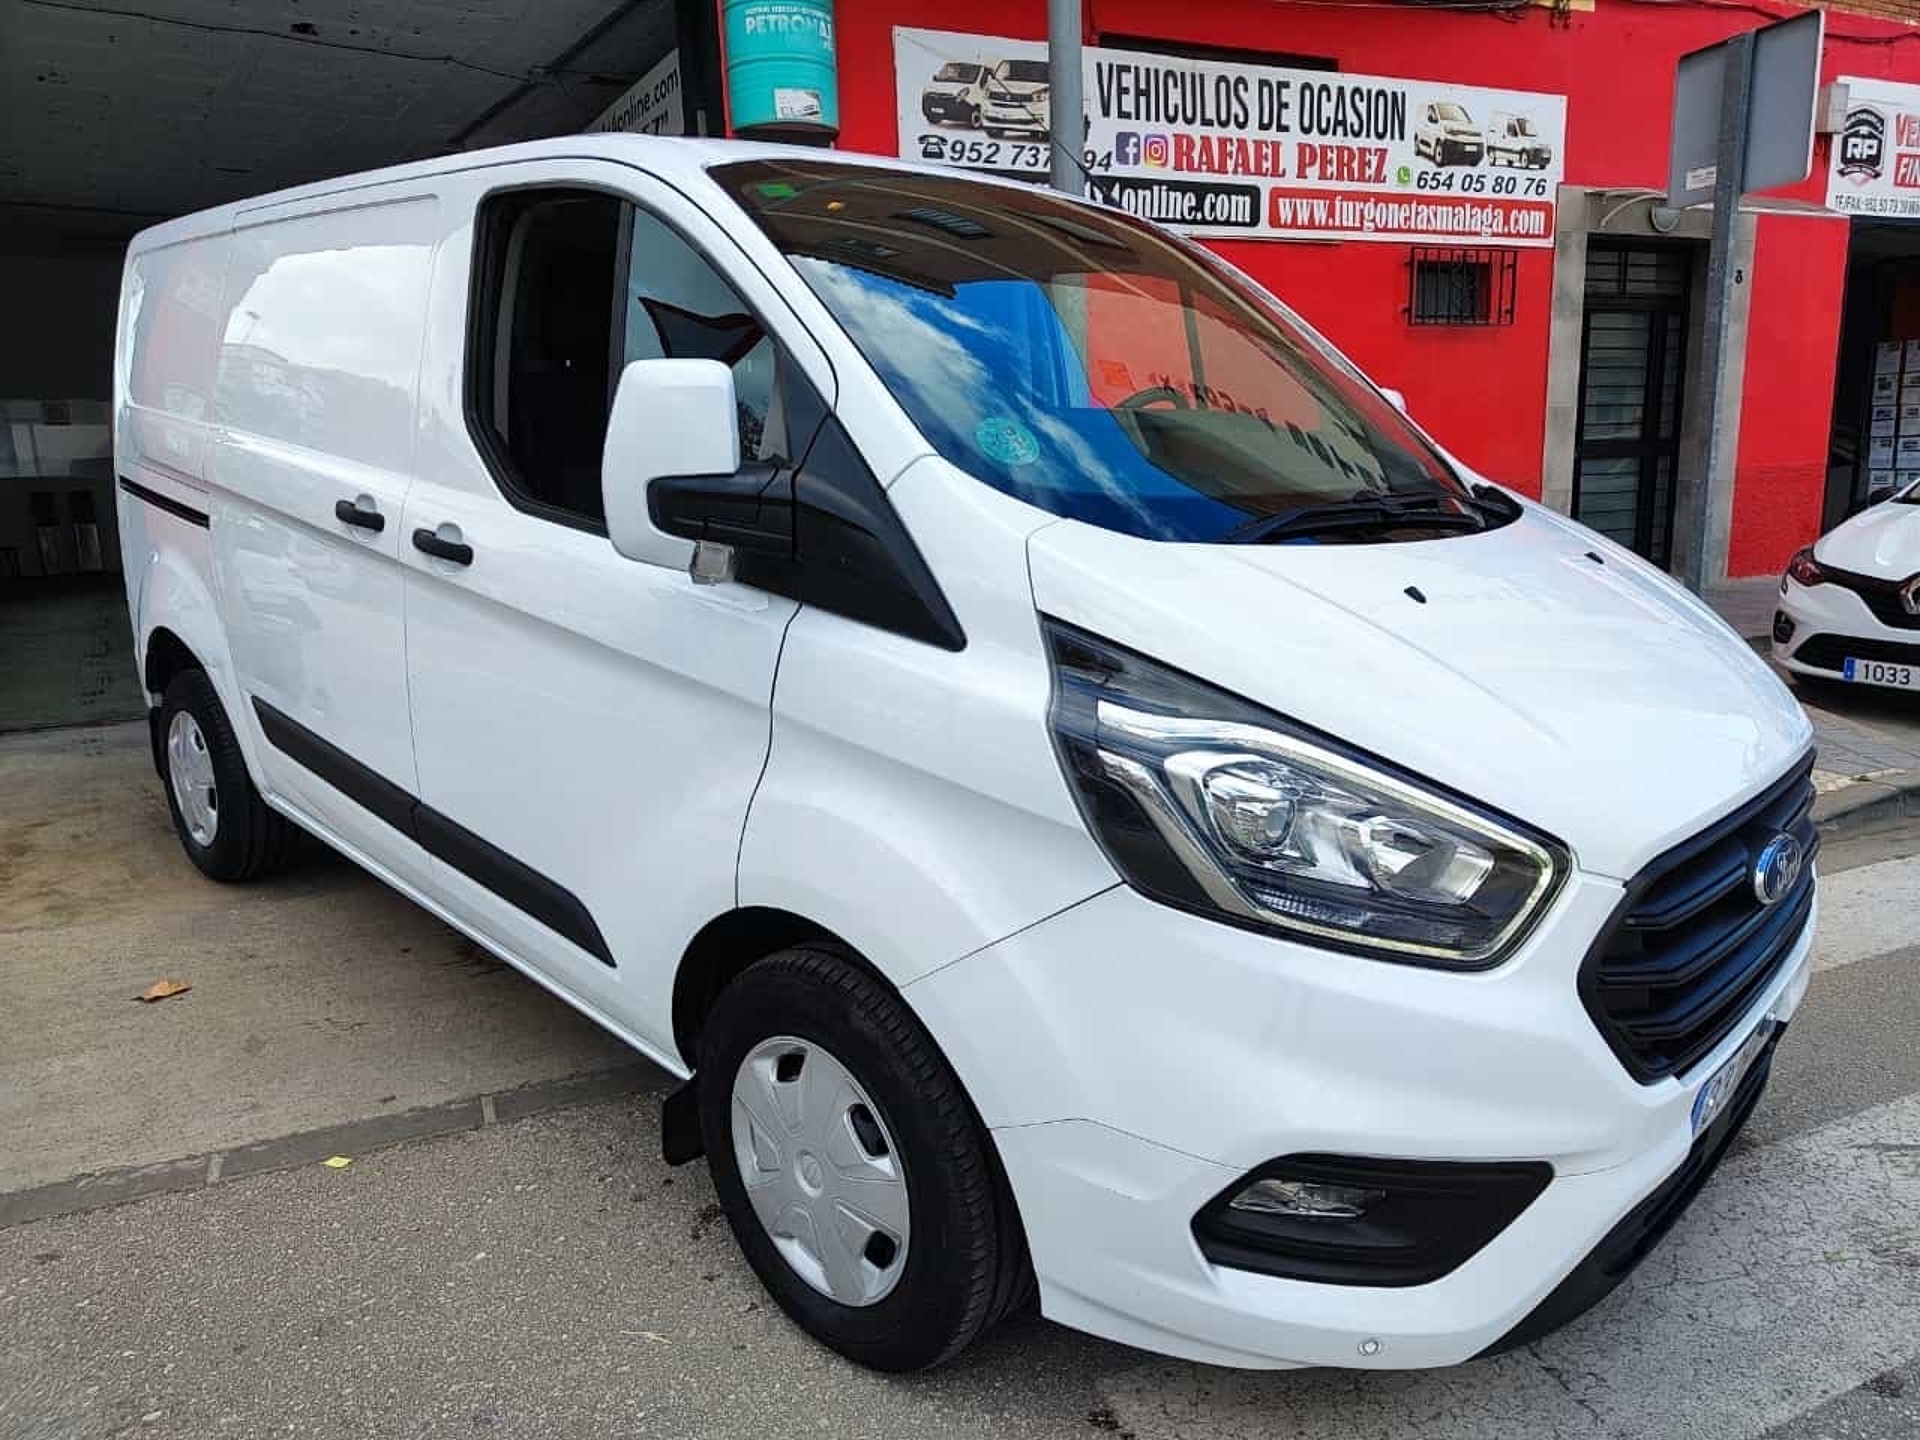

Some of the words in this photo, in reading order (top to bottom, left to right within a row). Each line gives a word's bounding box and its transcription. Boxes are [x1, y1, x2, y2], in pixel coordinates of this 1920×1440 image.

[1096, 62, 1249, 129] VEHICULOS
[1258, 78, 1291, 132] DE
[1299, 82, 1406, 141] OCASION
[950, 140, 1000, 165] 952
[1172, 133, 1286, 178] RAFAEL
[1296, 142, 1388, 183] PEREZ
[1847, 137, 1878, 160] RP
[1417, 171, 1454, 191] 654
[1461, 174, 1487, 192] 05
[1492, 176, 1516, 194] 80
[1523, 178, 1547, 196] 76
[1278, 196, 1546, 237] www.furgonetasmalaga.com
[1864, 664, 1911, 685] 1033
